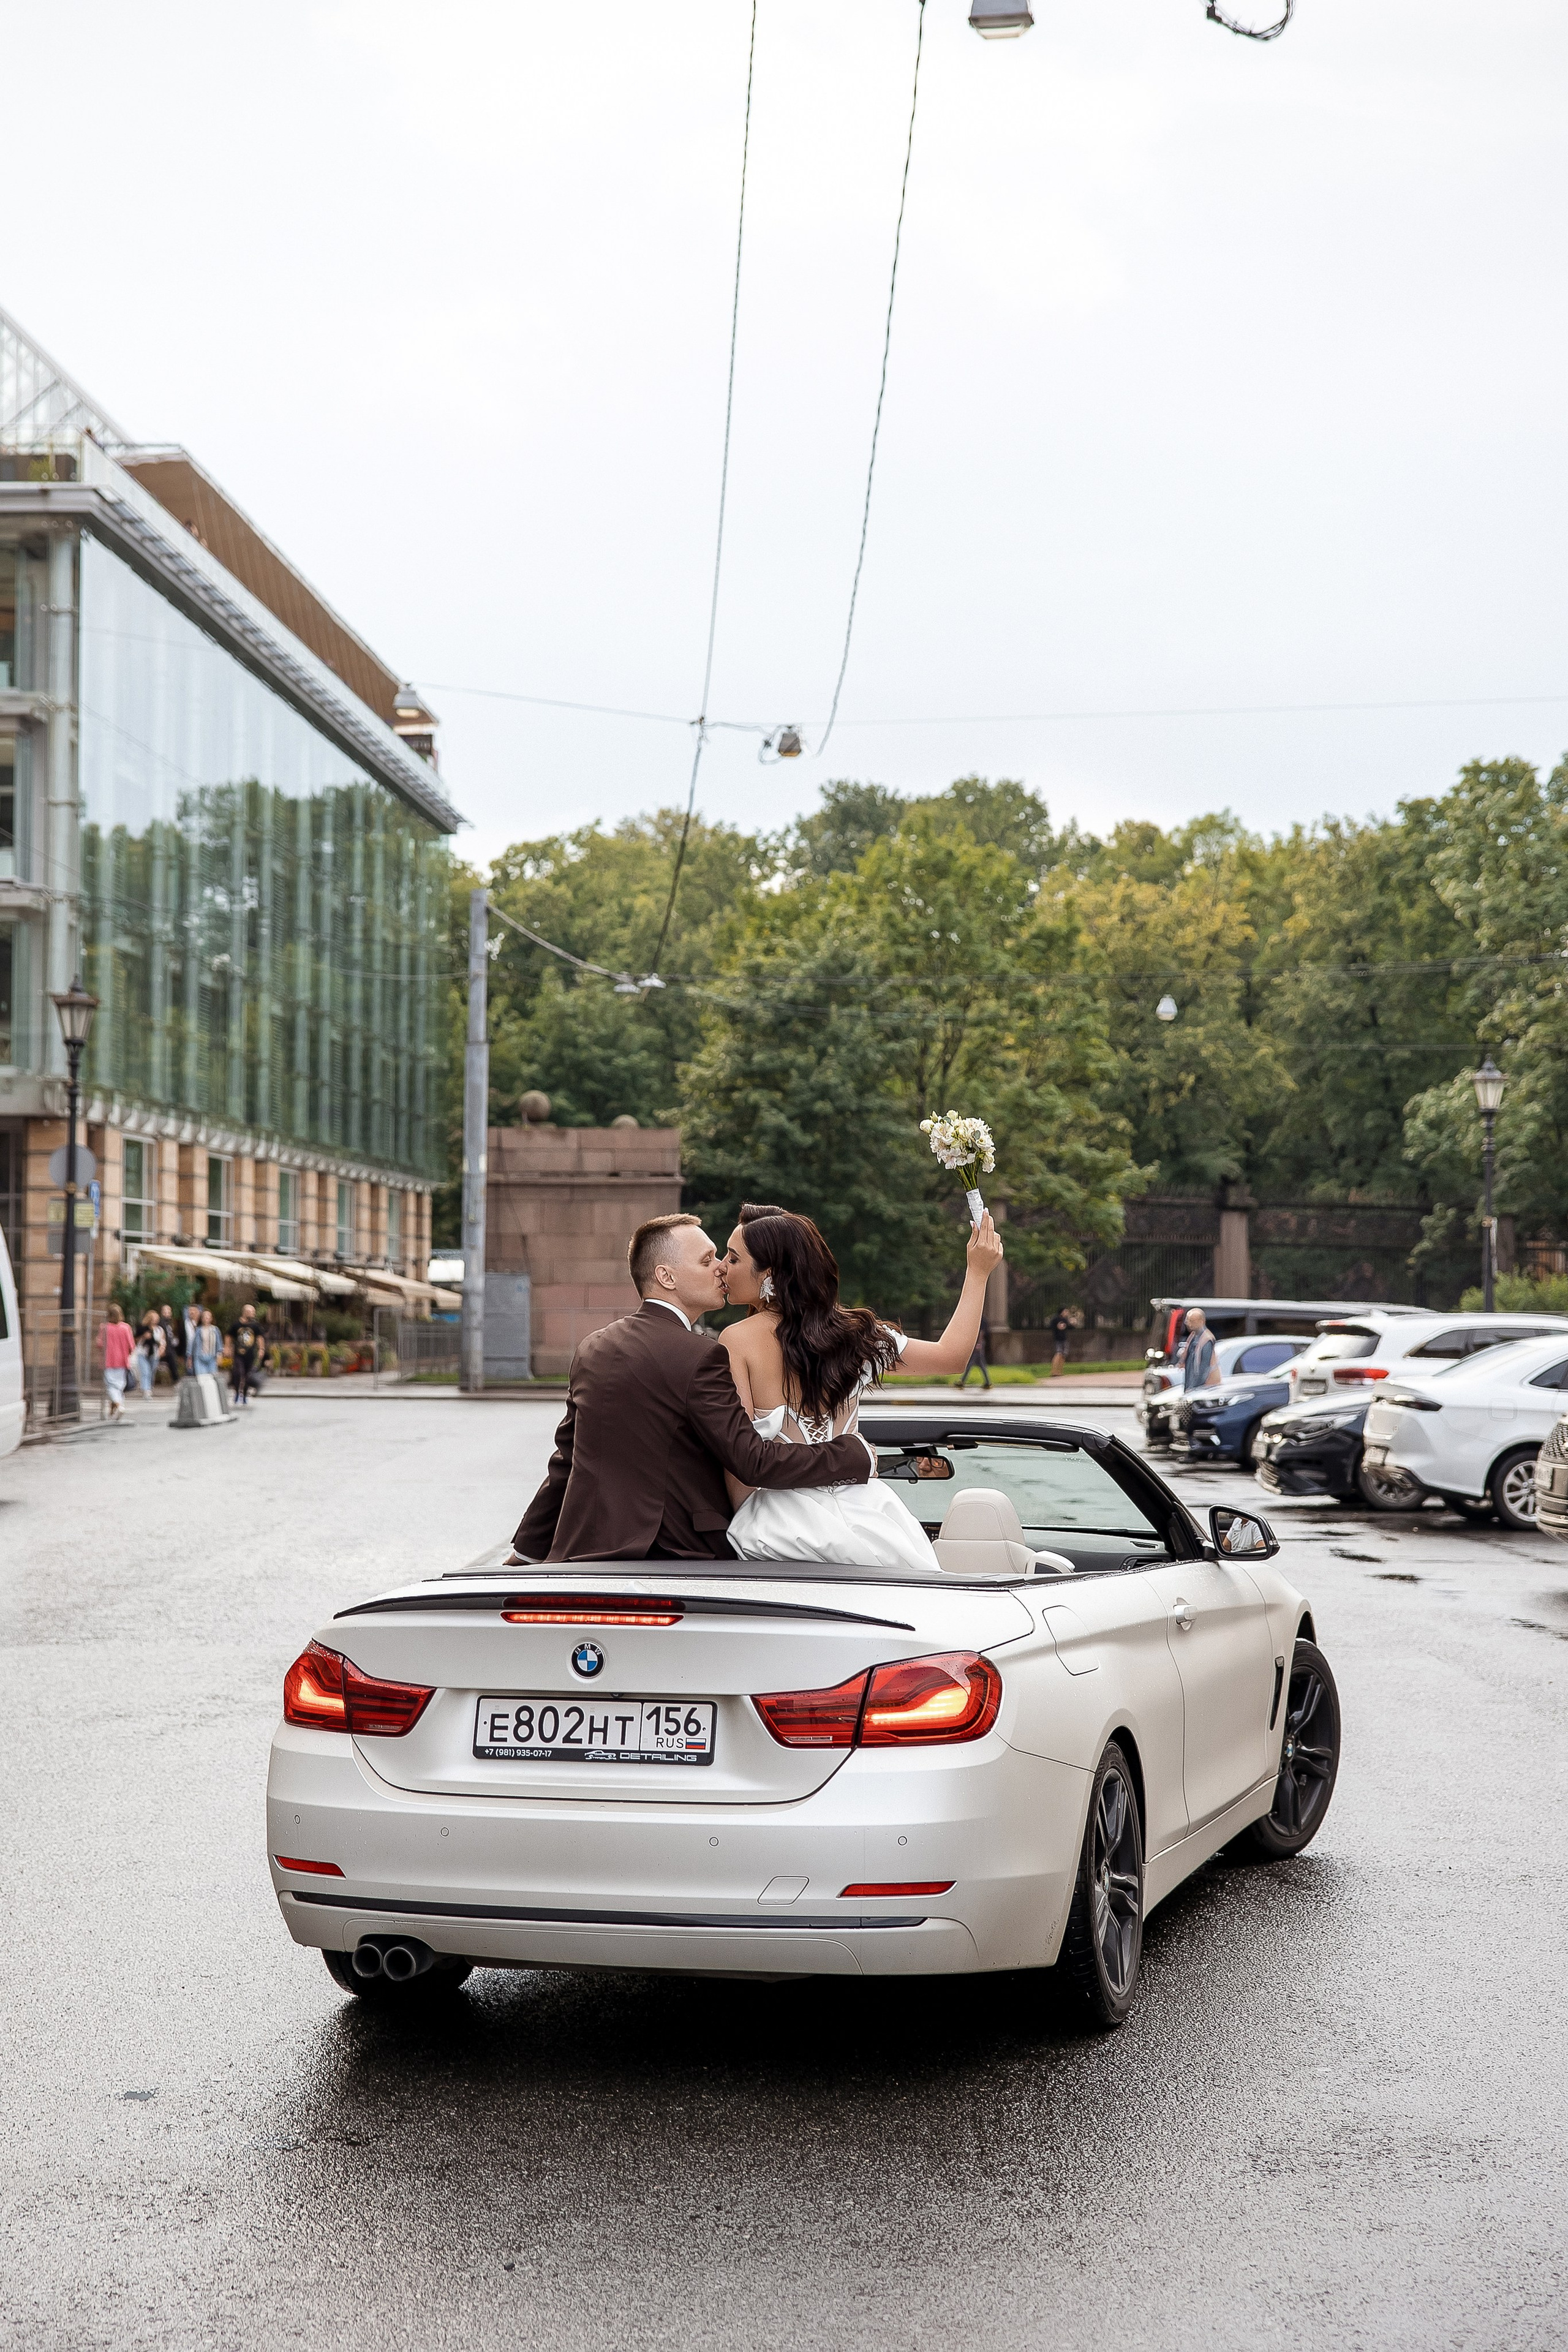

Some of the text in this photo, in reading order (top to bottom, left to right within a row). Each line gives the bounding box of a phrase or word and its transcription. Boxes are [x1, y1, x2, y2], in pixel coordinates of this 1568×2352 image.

[575, 1643, 601, 1655] BMW
[646, 1706, 701, 1736] 156
[656, 1737, 684, 1749] RUS
[495, 1748, 515, 1757] (981)
[516, 1749, 552, 1757] 935-07-17
[619, 1752, 697, 1762] DETAILING
